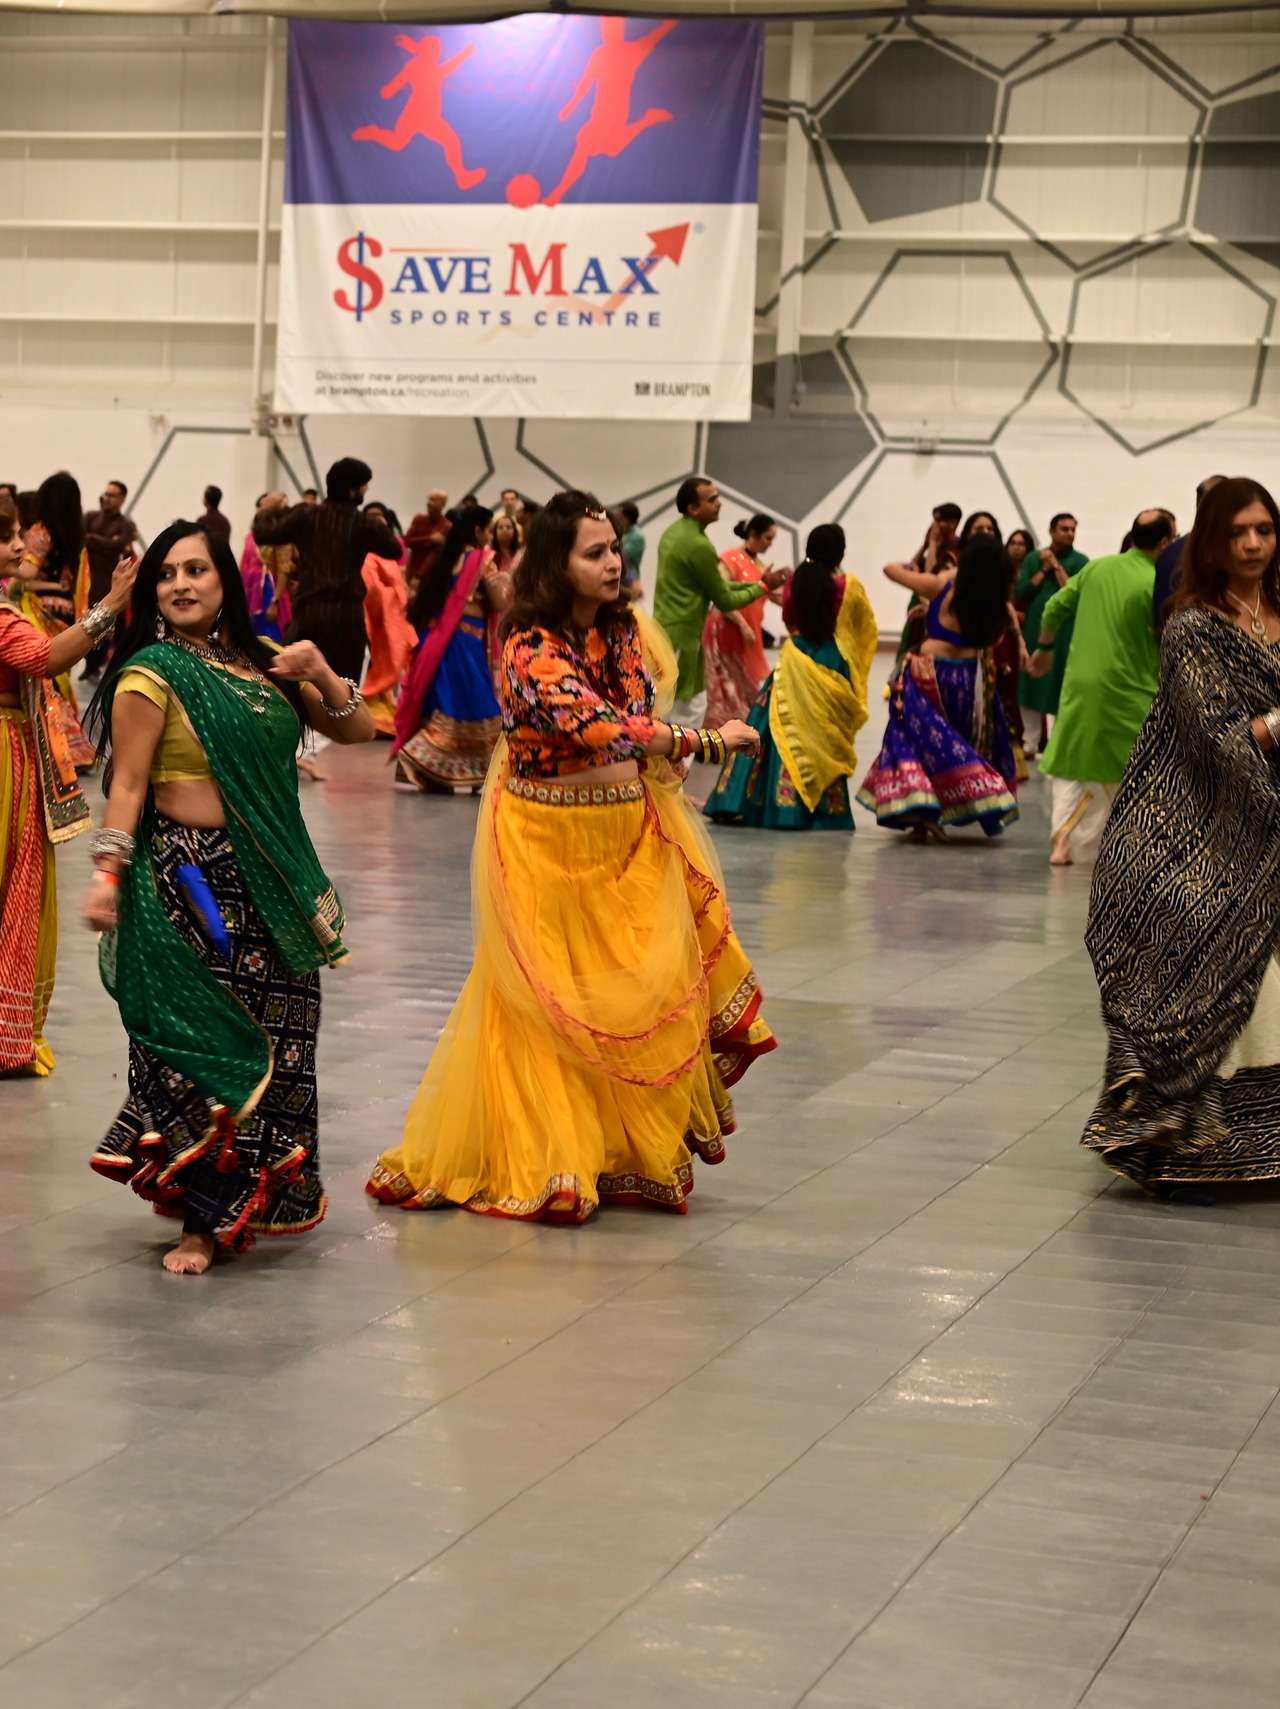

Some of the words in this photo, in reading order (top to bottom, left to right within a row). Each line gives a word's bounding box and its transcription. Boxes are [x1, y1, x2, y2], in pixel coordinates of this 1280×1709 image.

[504, 242, 660, 297] MAX
[391, 310, 512, 326] SPORTS
[534, 311, 661, 327] CENTRE
[316, 371, 365, 382] Discover
[369, 373, 393, 383] new
[396, 373, 453, 386] programs
[457, 373, 479, 385] and
[654, 382, 711, 396] BRAMPTON
